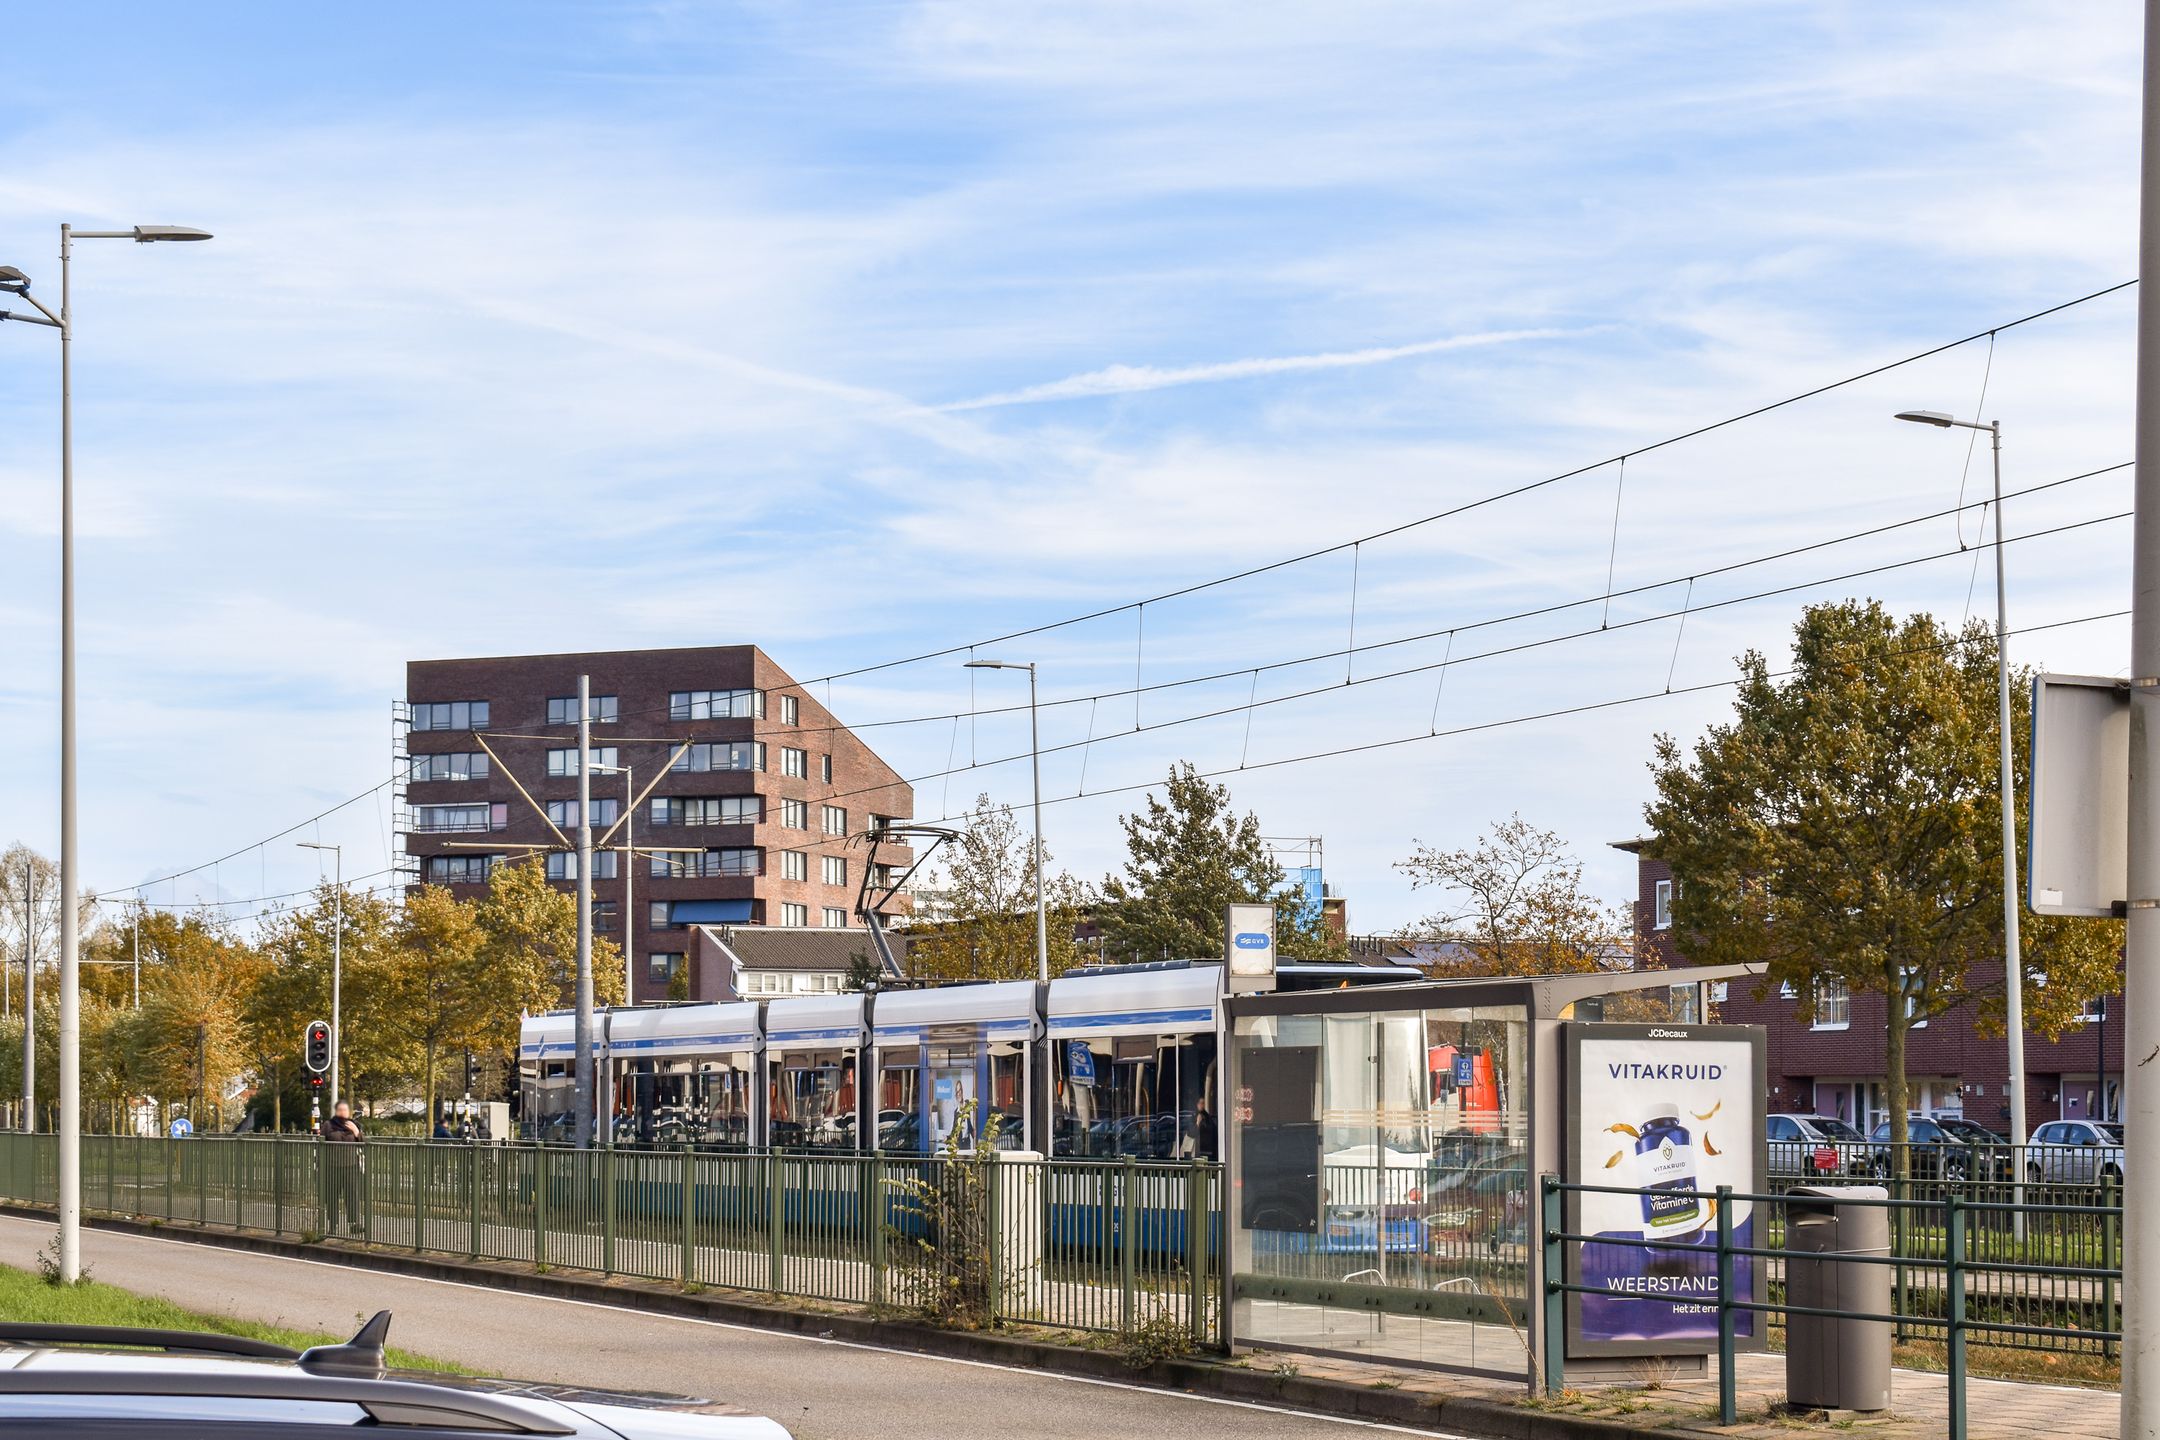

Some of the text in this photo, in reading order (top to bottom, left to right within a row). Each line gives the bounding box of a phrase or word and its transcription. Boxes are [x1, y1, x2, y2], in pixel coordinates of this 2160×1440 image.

[1648, 1028, 1688, 1038] JCDecaux
[1608, 1063, 1722, 1080] VITAKRUID
[1653, 1161, 1686, 1173] VITAKRUID
[1650, 1196, 1688, 1212] Vitamine
[1607, 1275, 1719, 1292] WEERSTAND
[1672, 1304, 1688, 1314] Het
[1689, 1303, 1701, 1314] zit
